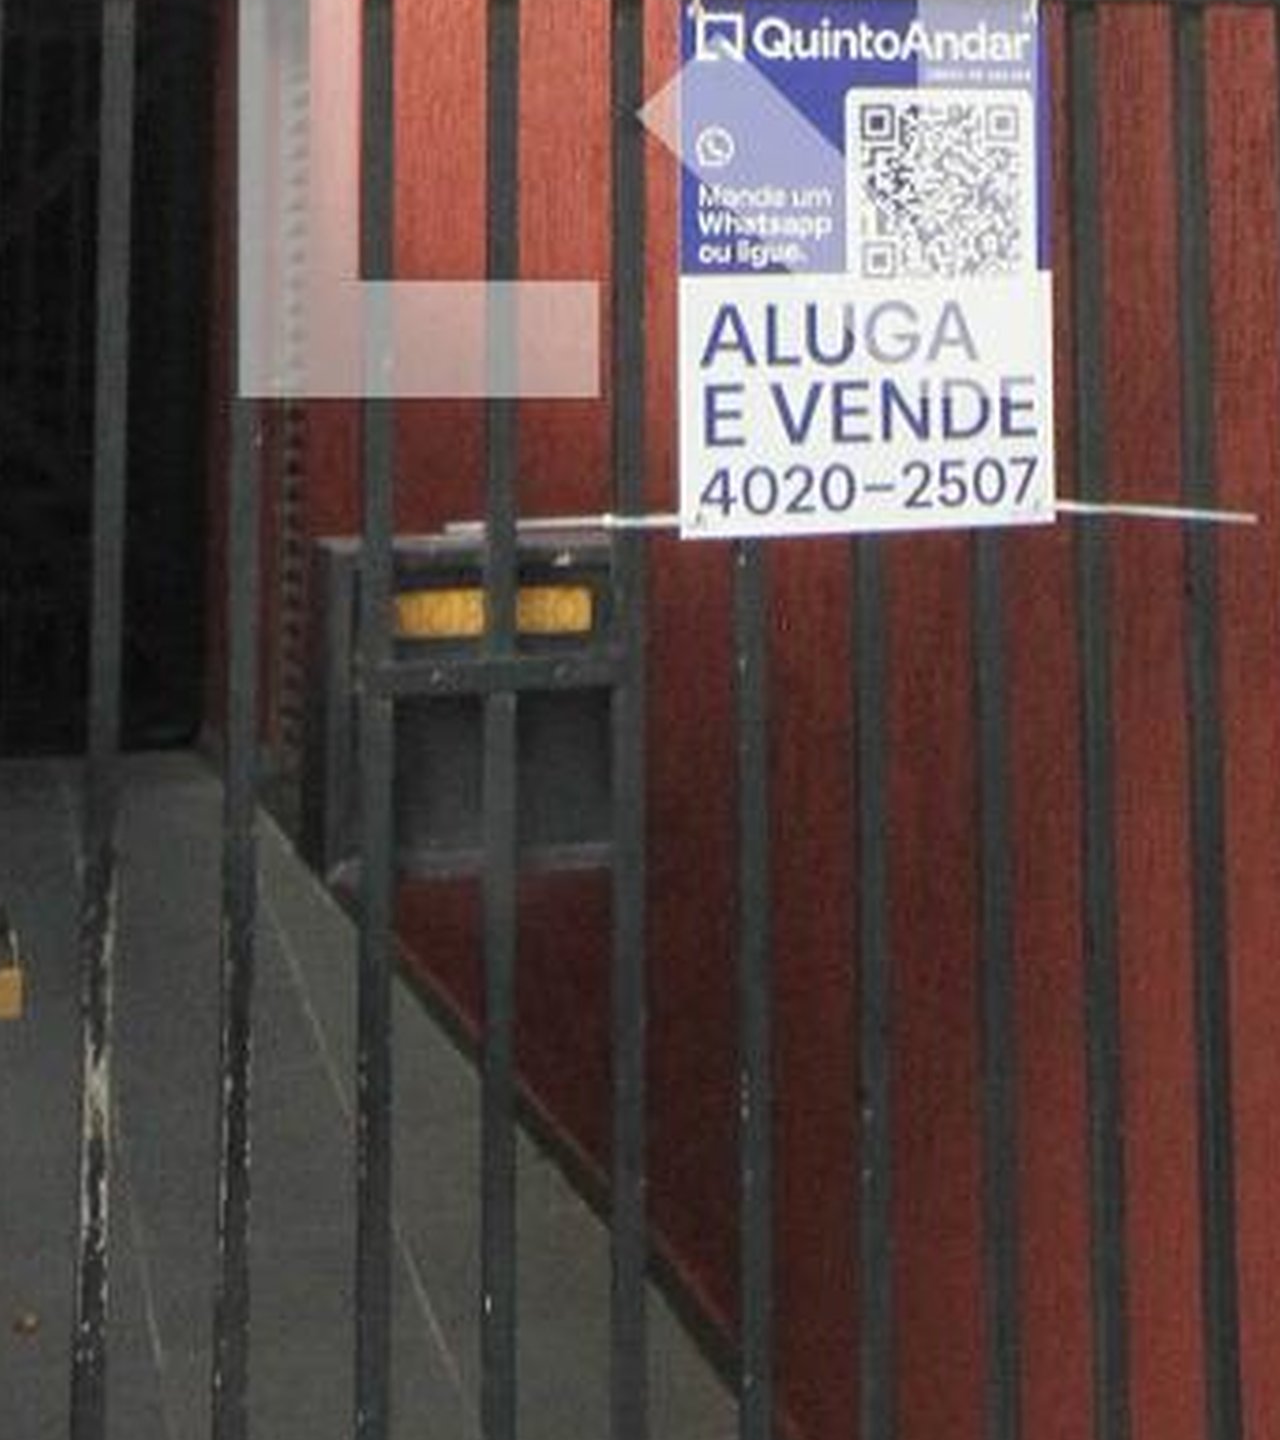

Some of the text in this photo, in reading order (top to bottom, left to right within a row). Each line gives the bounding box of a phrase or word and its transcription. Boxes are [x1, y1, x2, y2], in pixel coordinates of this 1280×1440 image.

[753, 17, 1032, 60] QuintoAndar
[698, 184, 833, 207] Mande um
[697, 211, 833, 240] Whatsapp
[698, 243, 731, 264] ou
[700, 300, 979, 368] ALUGA
[704, 376, 1038, 447] E VENDE
[699, 456, 1039, 517] 4020-2507
